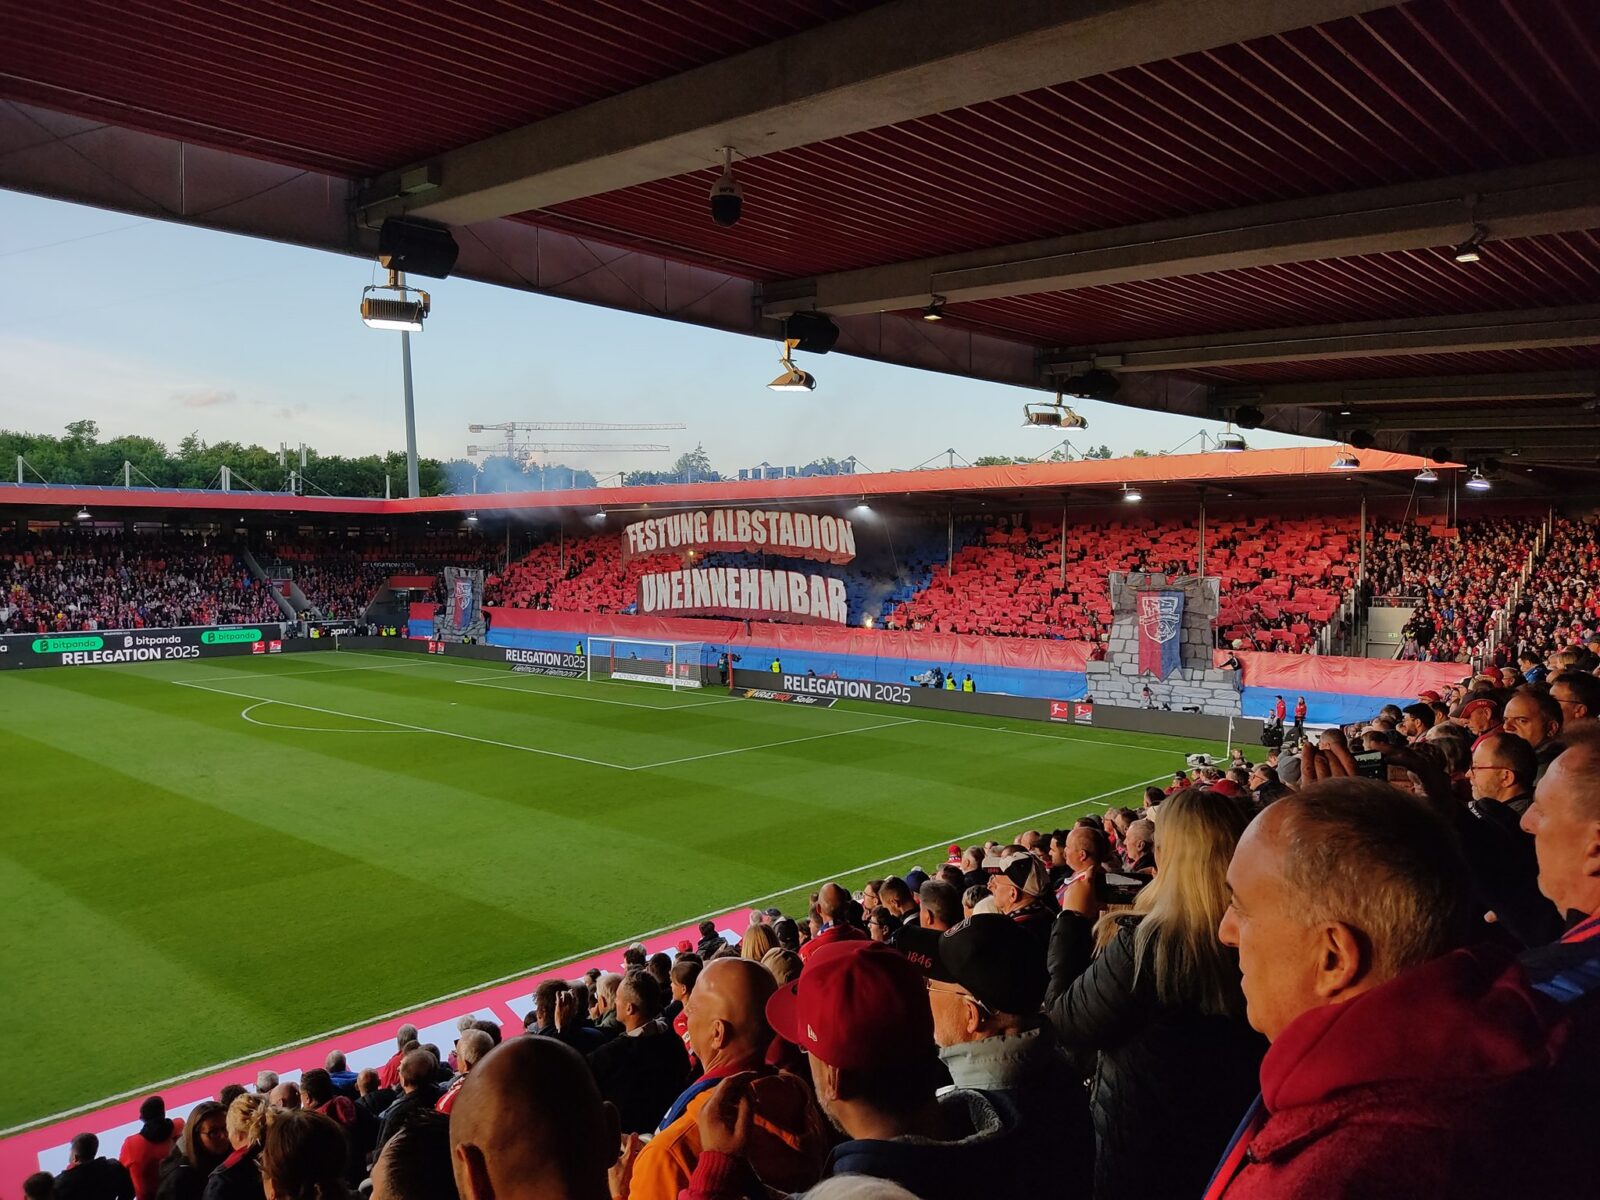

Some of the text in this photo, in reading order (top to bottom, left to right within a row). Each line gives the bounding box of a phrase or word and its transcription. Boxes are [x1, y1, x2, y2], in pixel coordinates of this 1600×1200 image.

[627, 510, 856, 555] FESTUNG ALBSTADION
[642, 568, 847, 624] UNEINNEHMBAR
[52, 640, 96, 650] bitpanda
[136, 635, 181, 647] bitpanda
[218, 632, 256, 641] bitpanda
[62, 645, 200, 665] RELEGATION 2025
[506, 649, 585, 668] RELEGATION 2025
[784, 675, 911, 704] RELEGATION 2025
[792, 695, 818, 704] Solar
[907, 951, 932, 968] 1846
